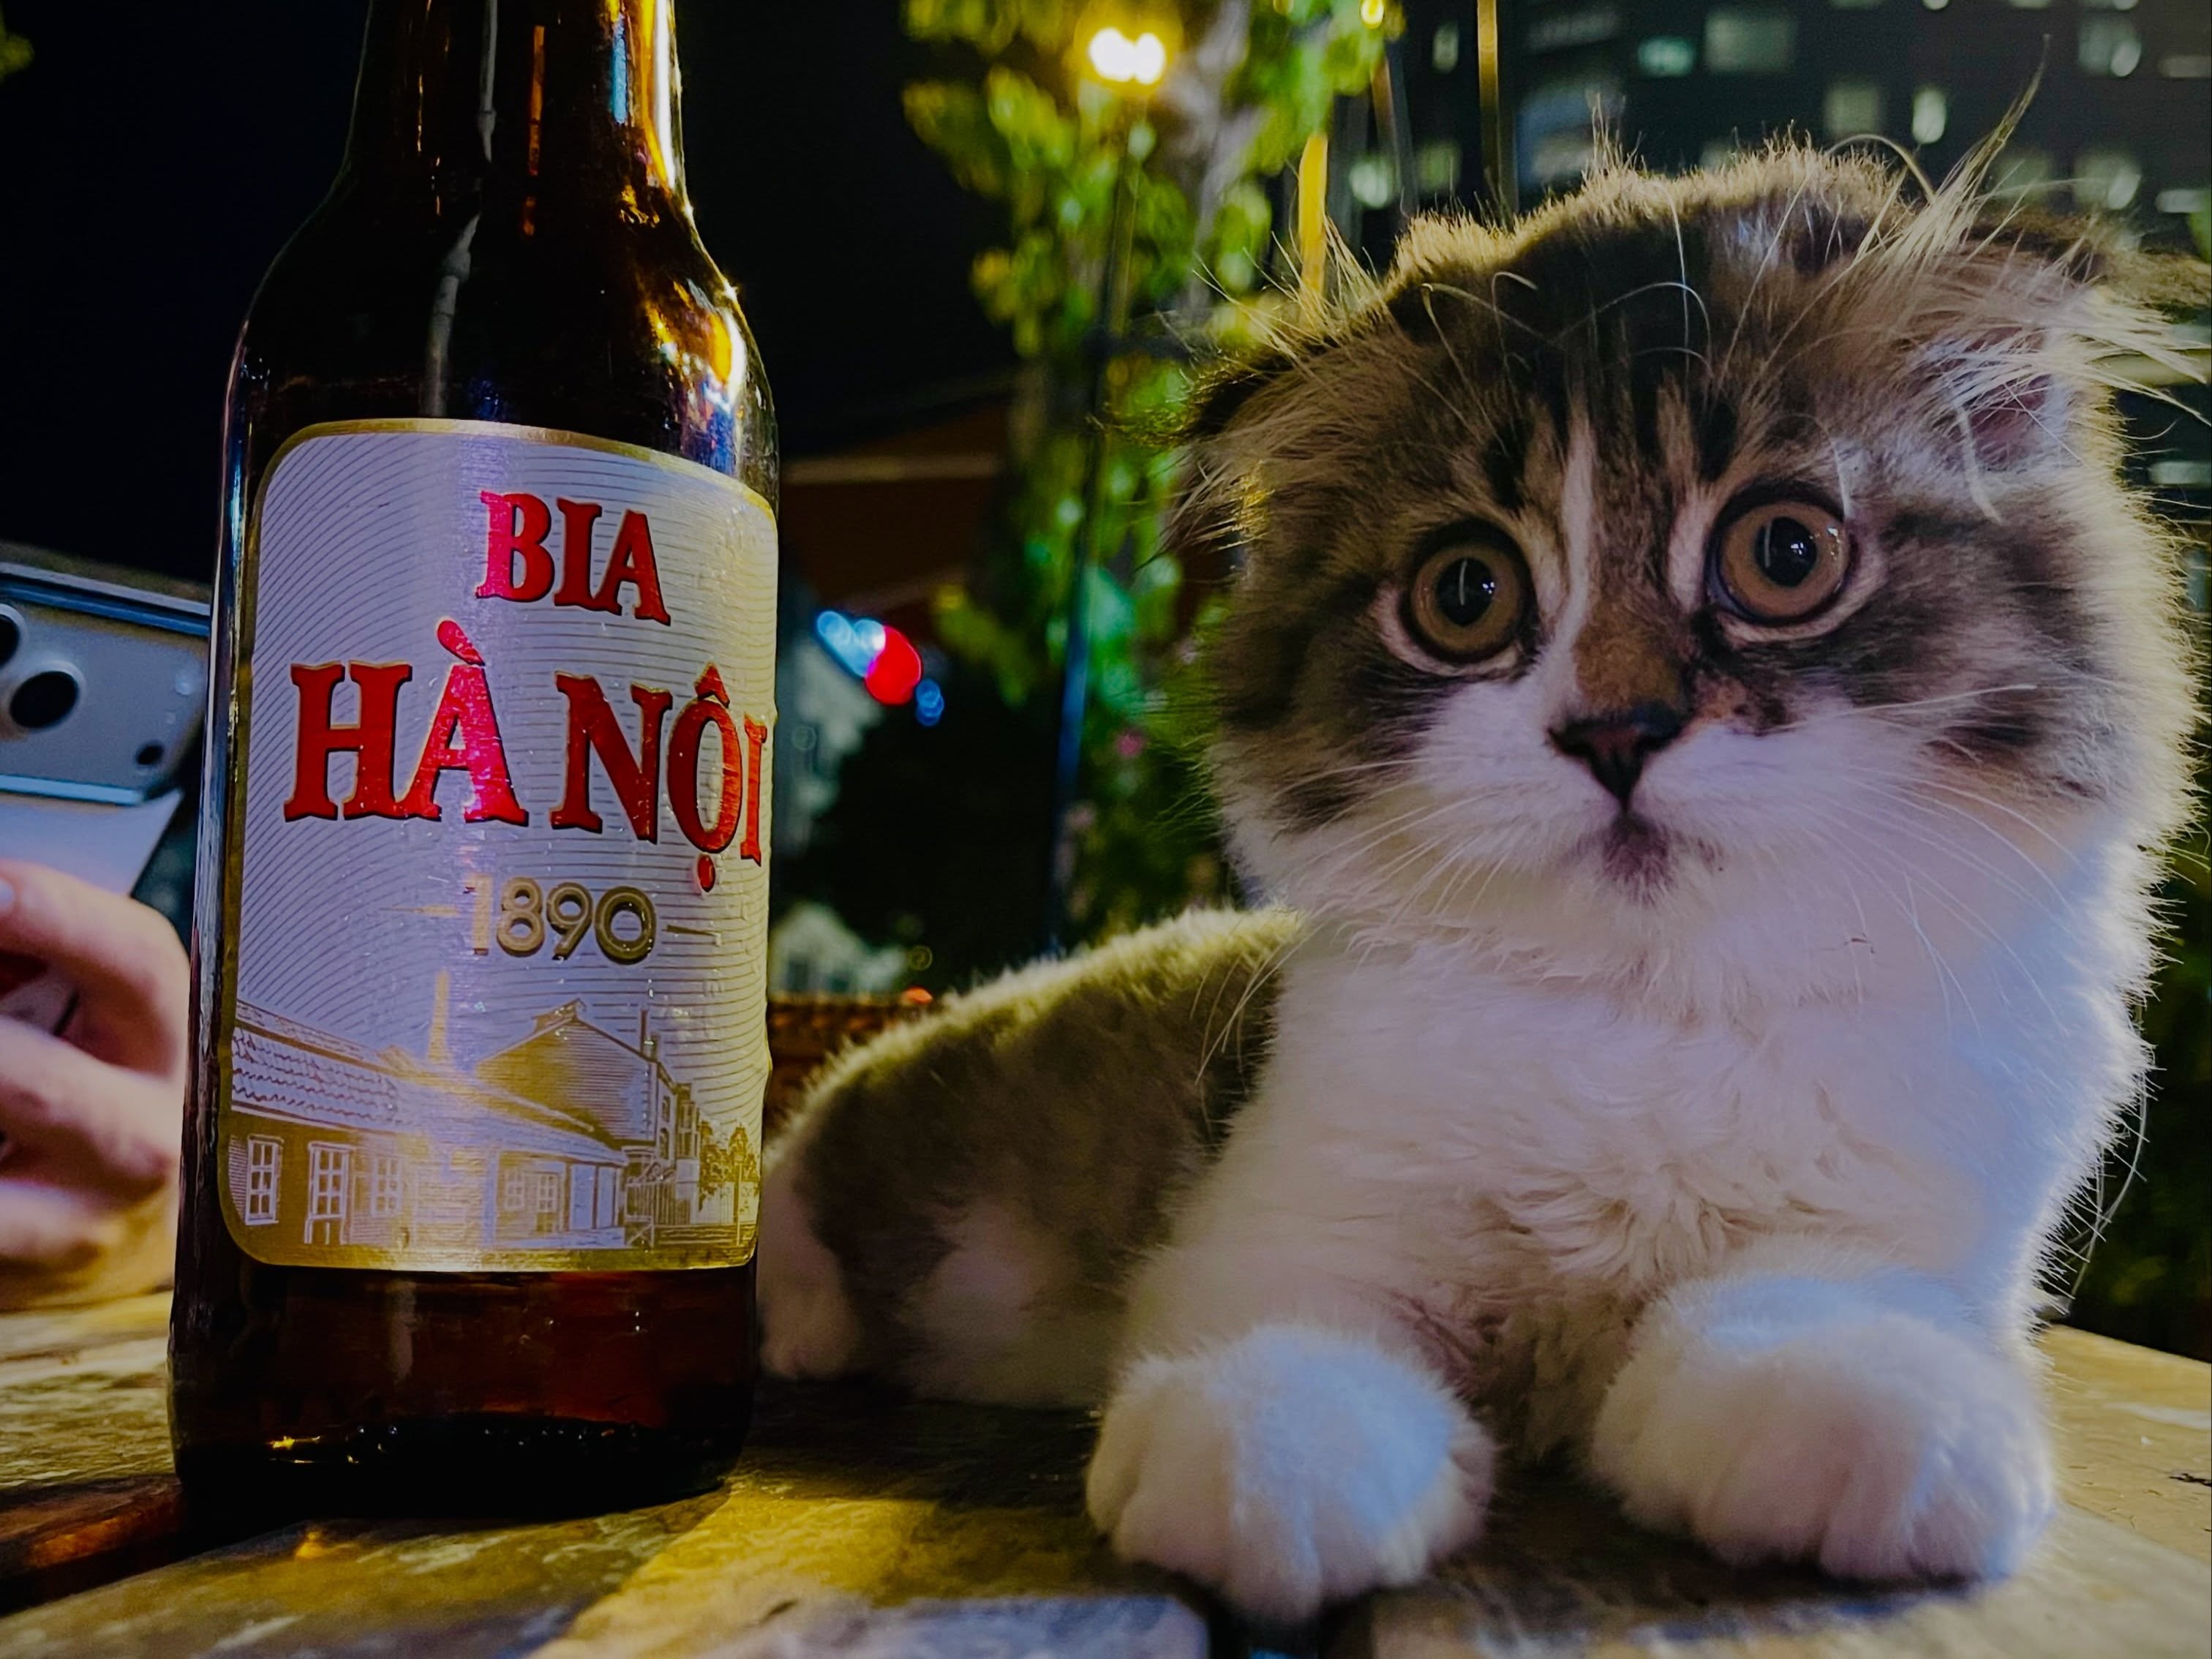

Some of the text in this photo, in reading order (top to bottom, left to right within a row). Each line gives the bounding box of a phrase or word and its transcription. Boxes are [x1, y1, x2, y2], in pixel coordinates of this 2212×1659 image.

[475, 489, 671, 625] BIA
[284, 619, 767, 892] HÀ NỘI
[464, 873, 658, 965] 1890
